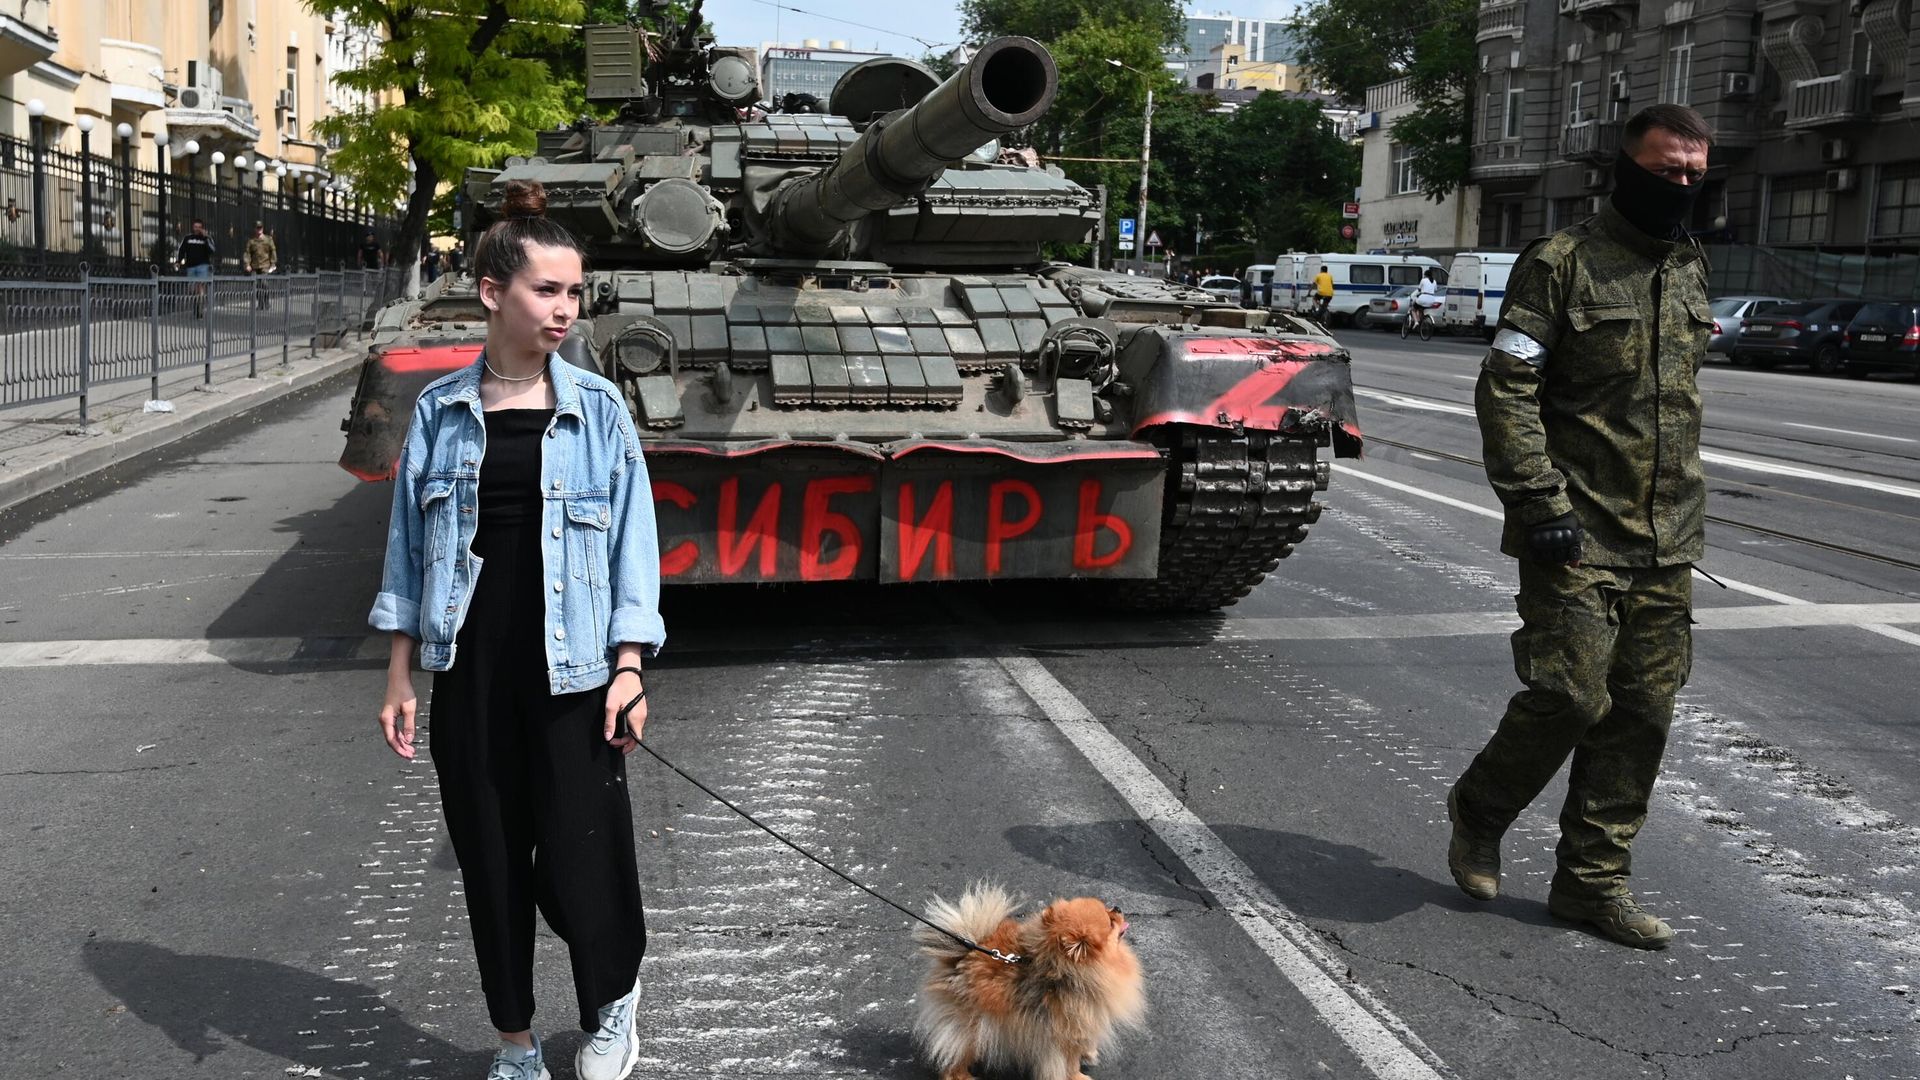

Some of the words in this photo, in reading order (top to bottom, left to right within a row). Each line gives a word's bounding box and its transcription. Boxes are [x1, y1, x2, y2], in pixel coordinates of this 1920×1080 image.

[783, 51, 811, 60] FORTE
[1122, 221, 1132, 233] P
[652, 474, 1133, 582] СИБИРЬ
